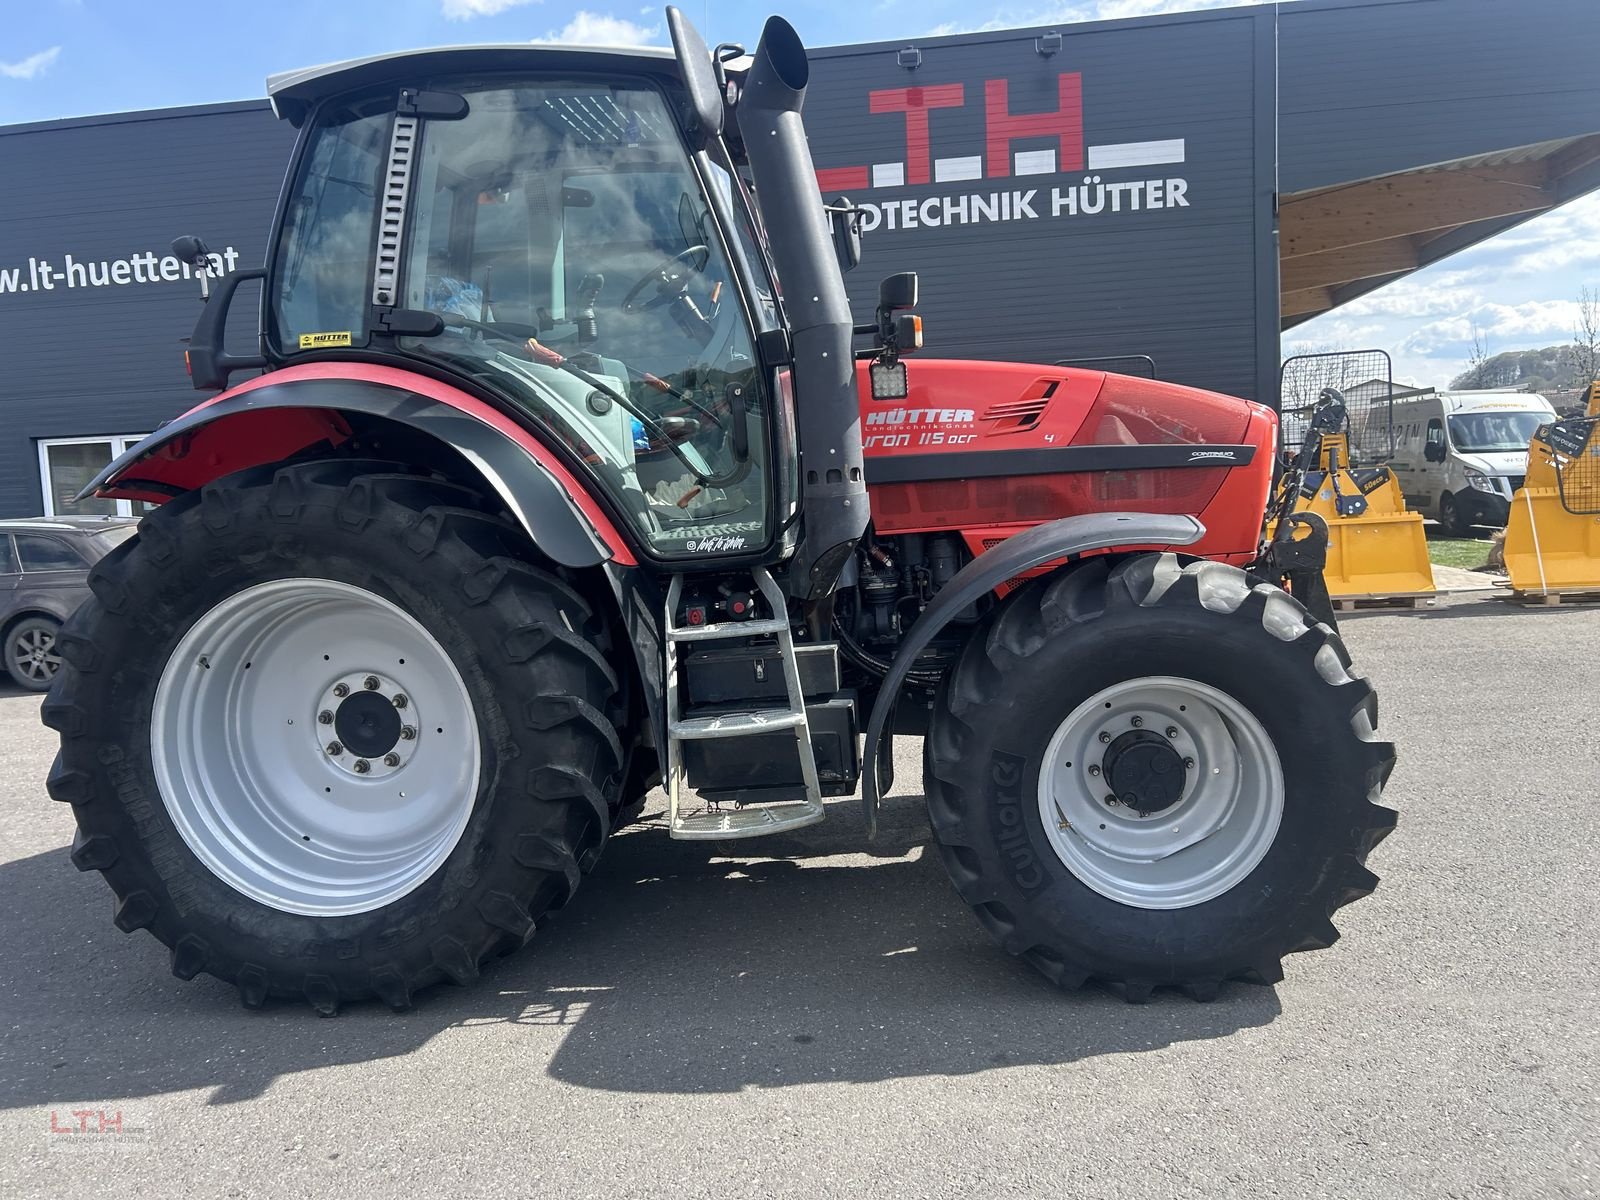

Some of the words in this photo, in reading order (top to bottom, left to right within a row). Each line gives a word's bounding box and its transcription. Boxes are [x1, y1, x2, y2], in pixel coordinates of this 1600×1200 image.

[1051, 175, 1190, 217] HÜTTER
[865, 407, 975, 425] HÜTTER
[864, 423, 975, 431] Landtechnik-Gnas
[919, 432, 945, 445] 115
